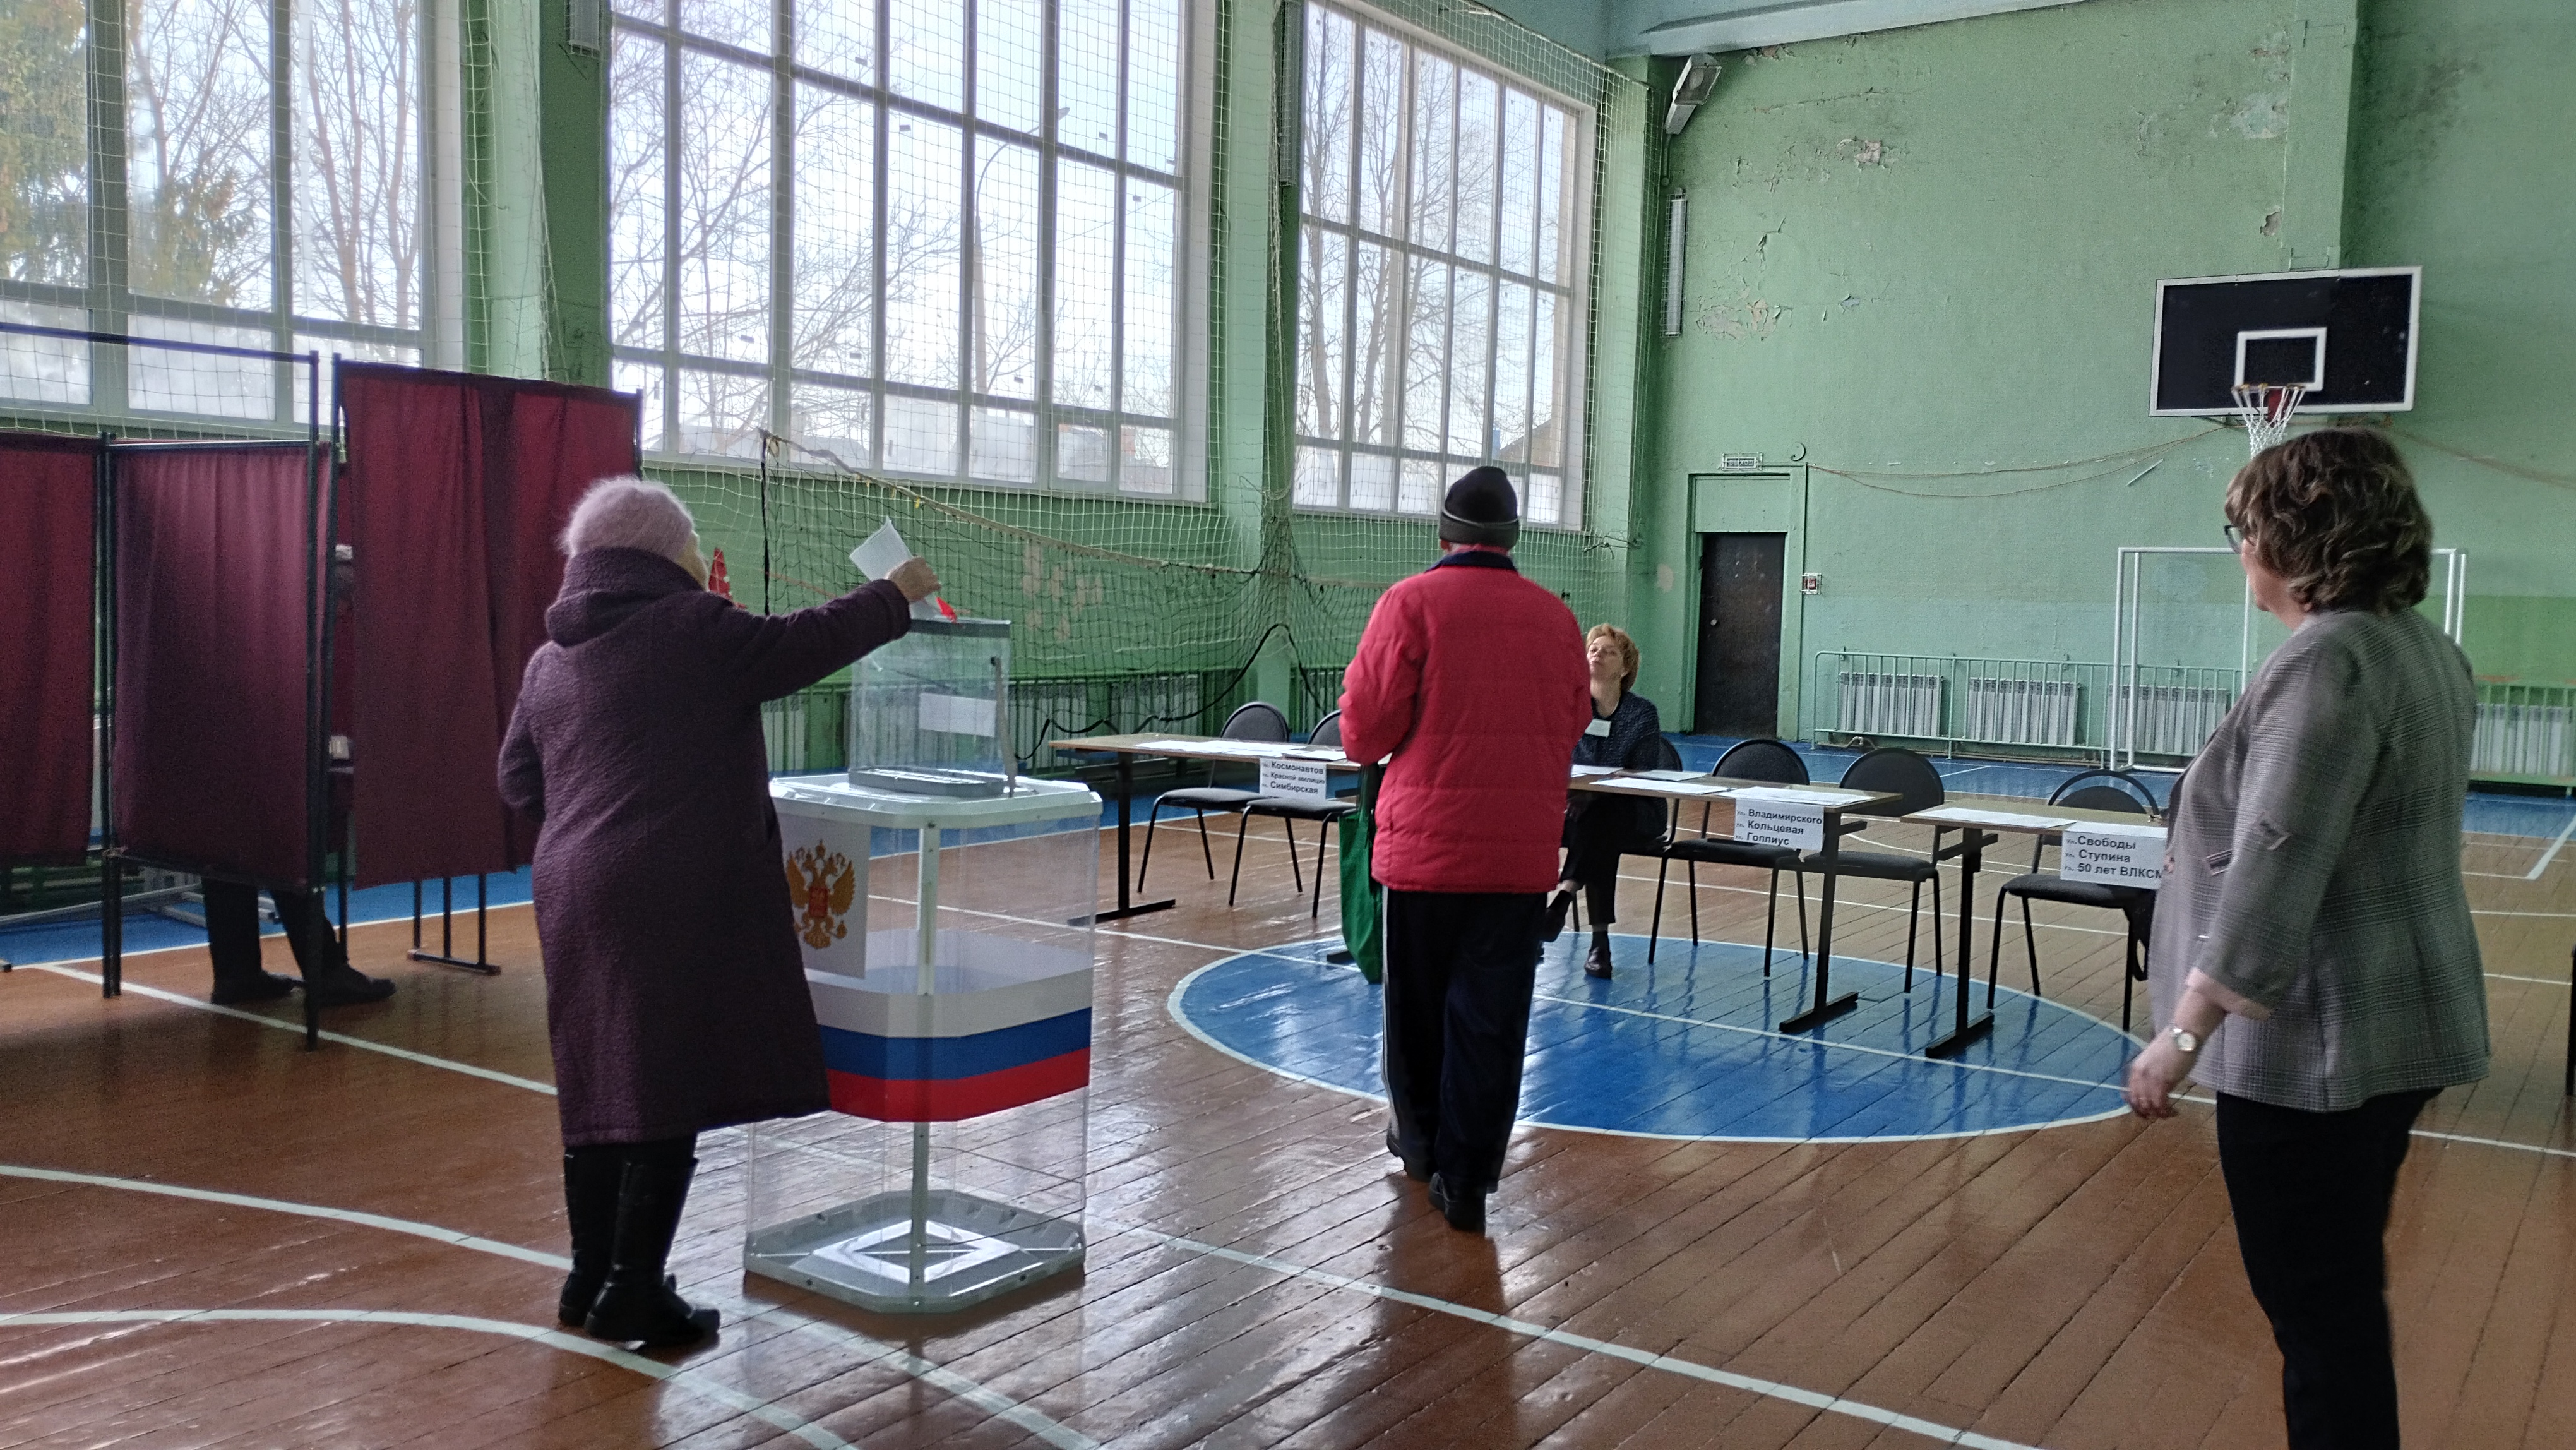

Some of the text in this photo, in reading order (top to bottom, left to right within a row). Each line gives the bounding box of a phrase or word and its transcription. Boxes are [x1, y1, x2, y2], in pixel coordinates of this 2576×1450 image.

[1272, 761, 1324, 774] Космонавтов
[1270, 781, 1318, 794] Симбирская
[1748, 808, 1822, 825] Владимирского
[1748, 820, 1804, 834] Кольцевая
[1746, 832, 1789, 846] Гоппиус
[2078, 836, 2136, 849] Свободы
[2078, 849, 2130, 863] Ступина
[2077, 863, 2092, 872] 50
[2095, 867, 2116, 875] лет
